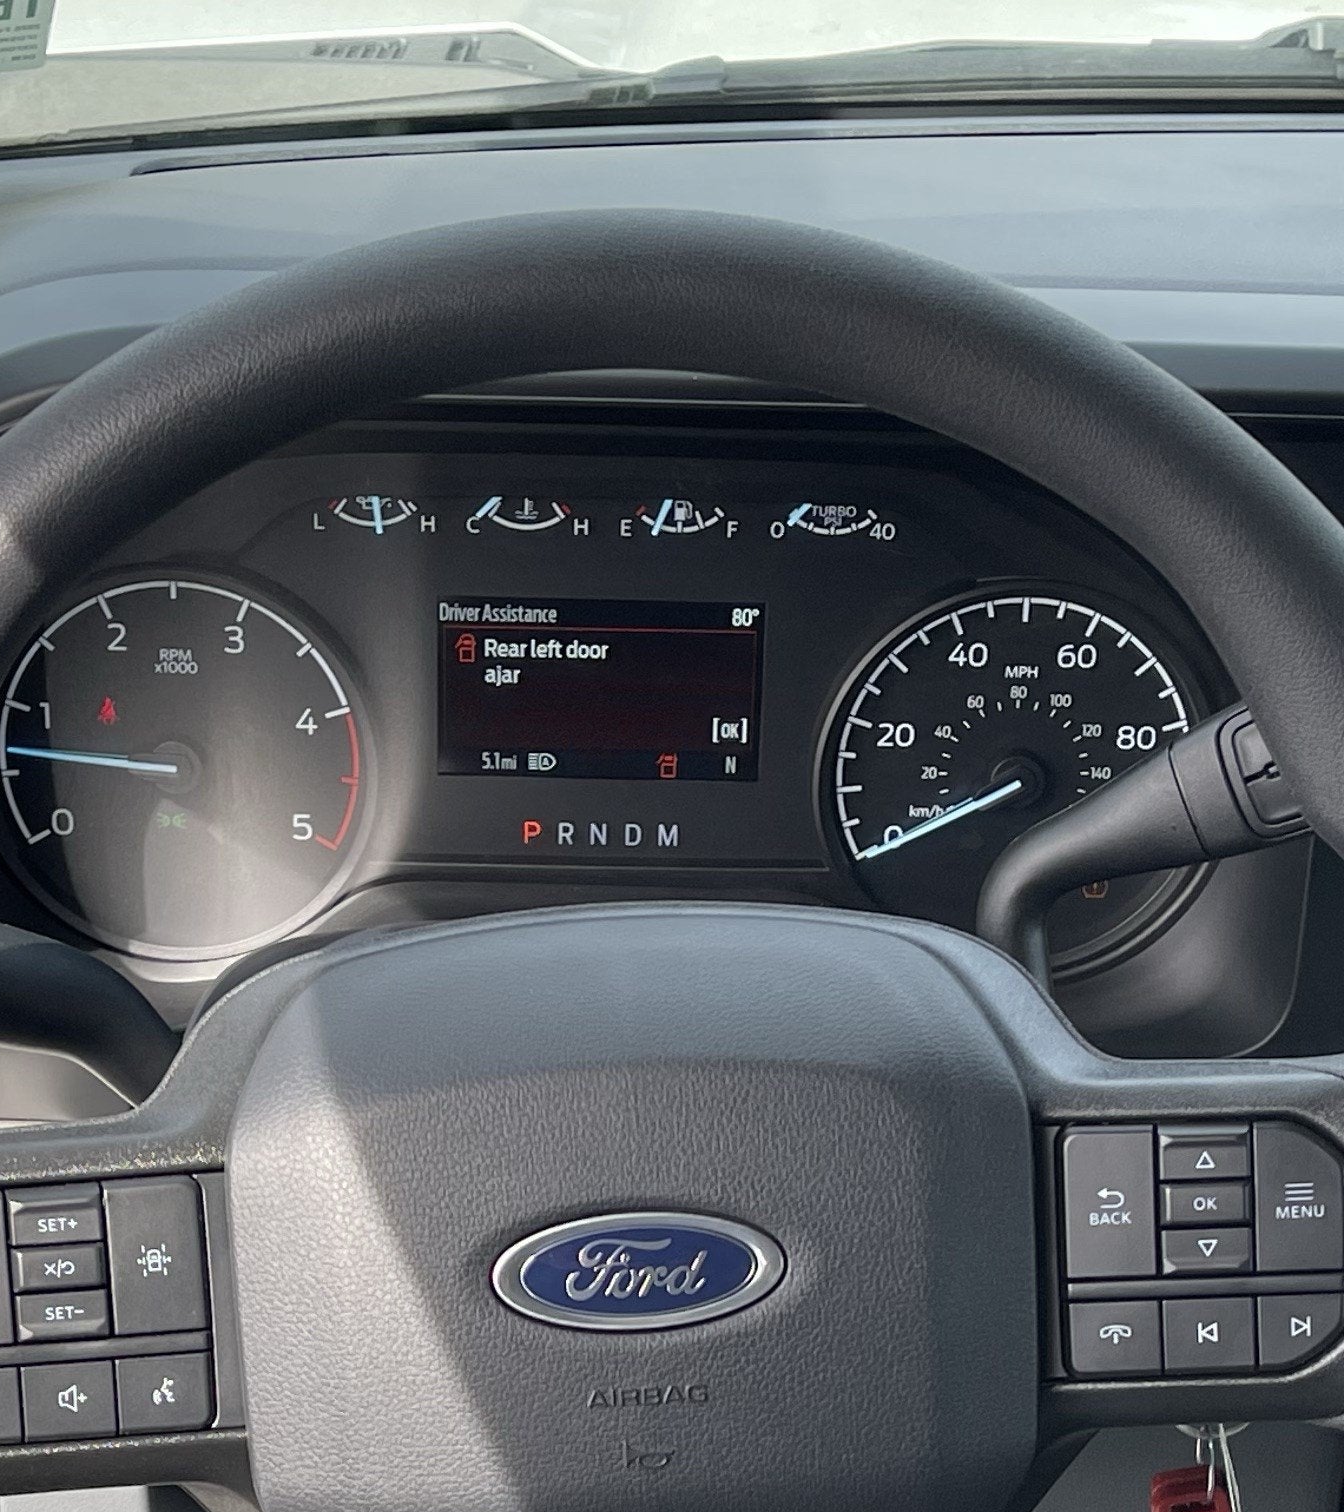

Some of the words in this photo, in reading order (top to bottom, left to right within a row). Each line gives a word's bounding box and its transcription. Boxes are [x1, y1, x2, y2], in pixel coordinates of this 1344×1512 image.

[811, 505, 857, 518] TURBO
[313, 513, 325, 530] L
[420, 515, 436, 532] H
[466, 516, 480, 534] C
[573, 518, 589, 536] H
[620, 519, 632, 537] E
[726, 521, 738, 538] F
[869, 523, 895, 540] 40
[439, 603, 480, 622] Driver
[482, 604, 557, 623] Assistance
[107, 623, 127, 652] 2
[224, 625, 245, 654] 3
[159, 649, 193, 662] RPM
[484, 639, 526, 658] Rear
[530, 640, 562, 659] left
[565, 641, 608, 659] door
[948, 643, 988, 668] 40
[1057, 644, 1097, 669] 60
[154, 662, 198, 675] x1000
[484, 666, 520, 686] ajar
[1004, 666, 1039, 680] MPH
[1010, 685, 1027, 700] 80
[1050, 694, 1072, 708] 100
[967, 695, 984, 709] 60
[39, 702, 51, 729] 1
[295, 708, 318, 735] 4
[876, 722, 915, 748] 20
[934, 725, 951, 739] 40
[1082, 723, 1102, 738] 120
[1116, 726, 1156, 750] 80
[725, 756, 736, 774] N
[921, 766, 938, 779] 20
[1091, 766, 1111, 779] 140
[51, 808, 74, 836] 0
[292, 814, 313, 840] 5
[523, 820, 542, 844] P
[558, 822, 574, 846] R
[590, 823, 606, 846] N
[625, 824, 642, 846] D
[657, 824, 679, 847] M
[1193, 1197, 1217, 1211] OK
[1276, 1205, 1325, 1219] MENU
[38, 1217, 78, 1233] SET+
[1089, 1211, 1132, 1226] BACK
[565, 1237, 707, 1301] Ford
[586, 1384, 707, 1408] AIRBAG
